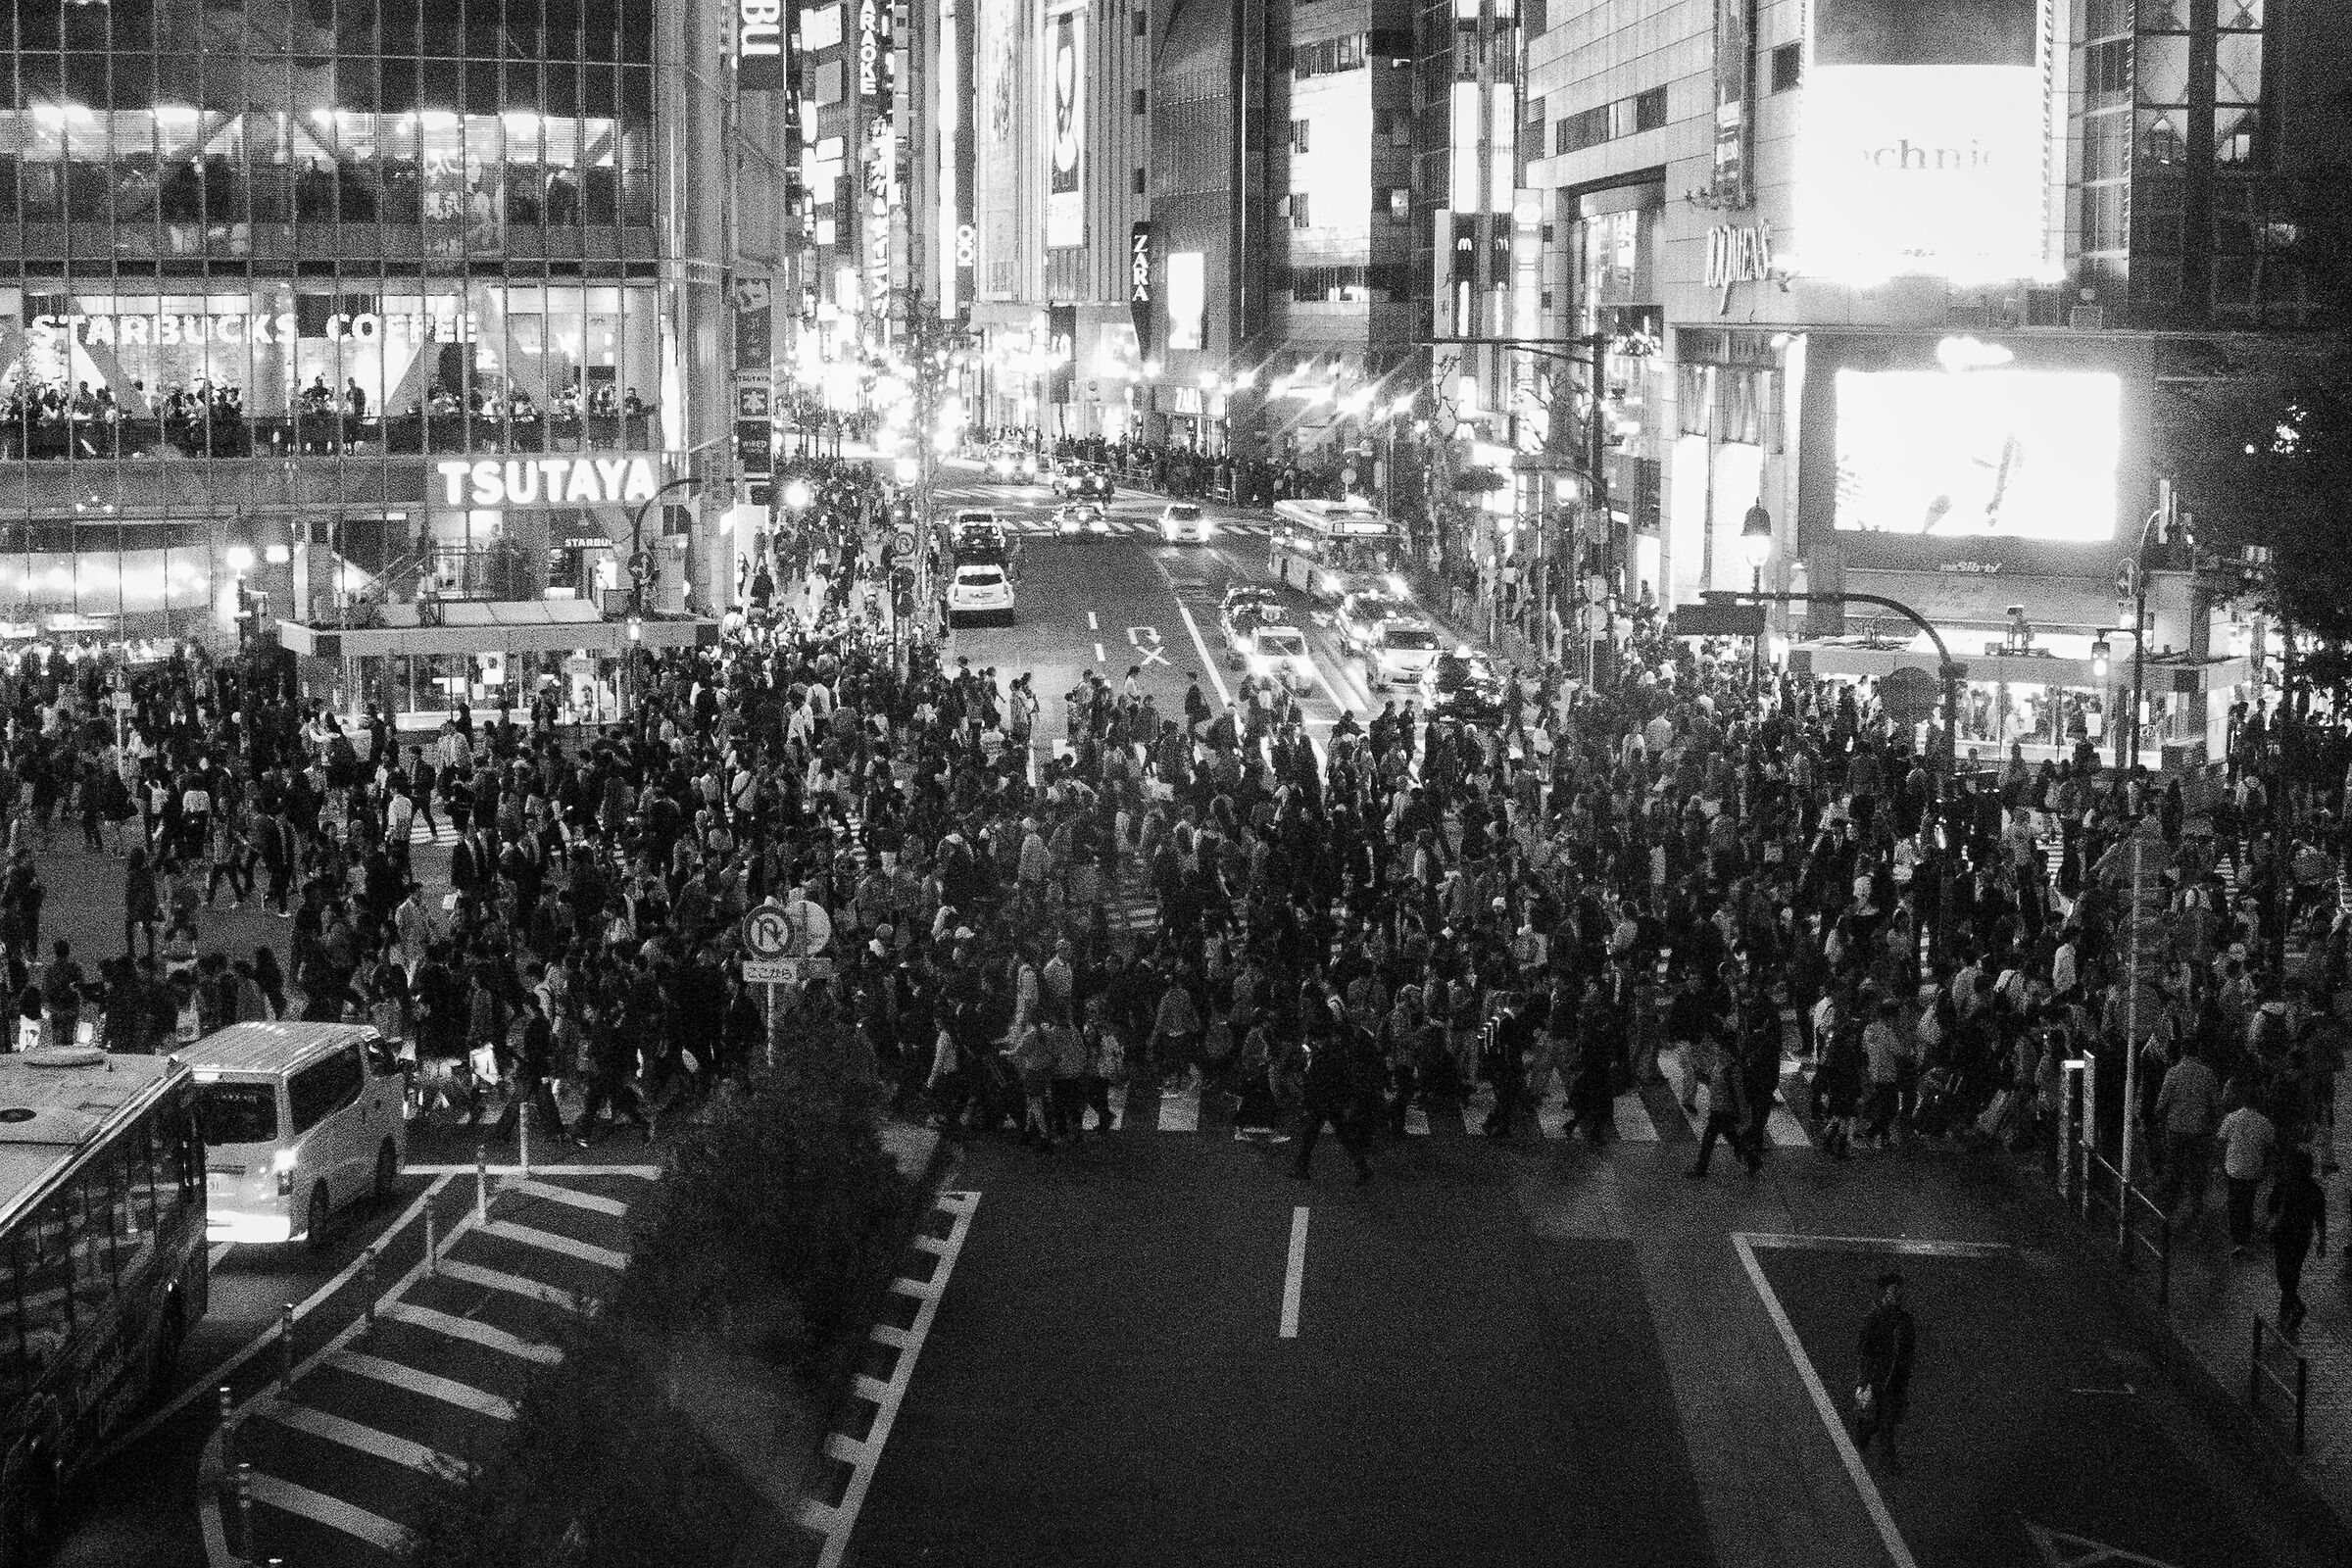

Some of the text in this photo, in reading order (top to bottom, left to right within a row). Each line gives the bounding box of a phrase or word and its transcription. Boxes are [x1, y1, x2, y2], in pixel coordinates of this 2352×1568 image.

[1133, 234, 1150, 302] ZARA
[30, 313, 478, 346] STARBUCKS COFFEE
[437, 458, 658, 506] TSUTAYA
